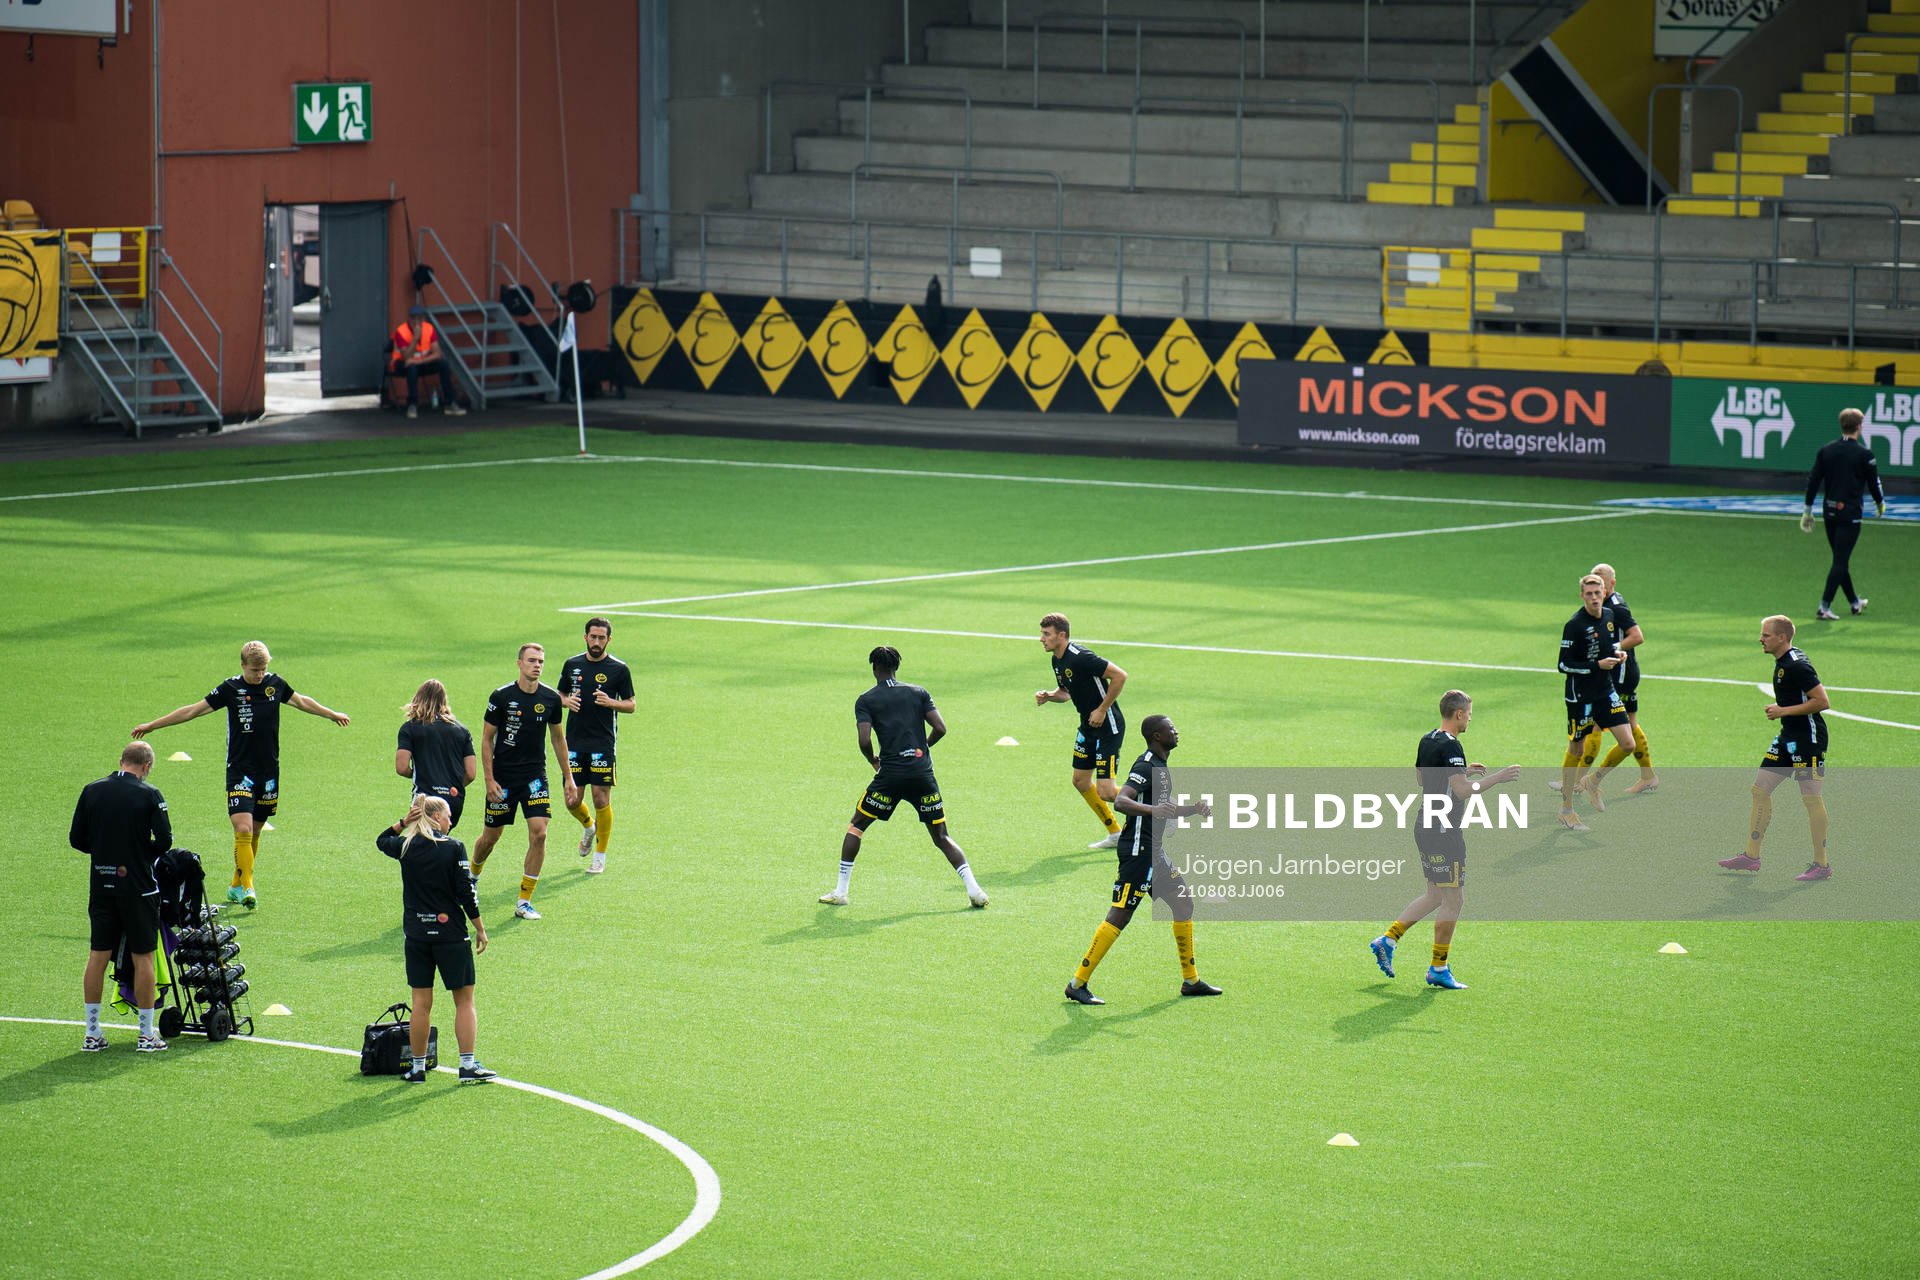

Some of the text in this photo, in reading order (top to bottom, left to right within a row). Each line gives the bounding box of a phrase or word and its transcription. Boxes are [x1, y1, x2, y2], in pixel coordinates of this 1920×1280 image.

[1727, 386, 1782, 416] LBC
[1298, 428, 1420, 445] www.mickson.com
[1455, 426, 1606, 455] företagsreklam
[530, 790, 549, 799] ellos
[920, 802, 943, 812] Cerner
